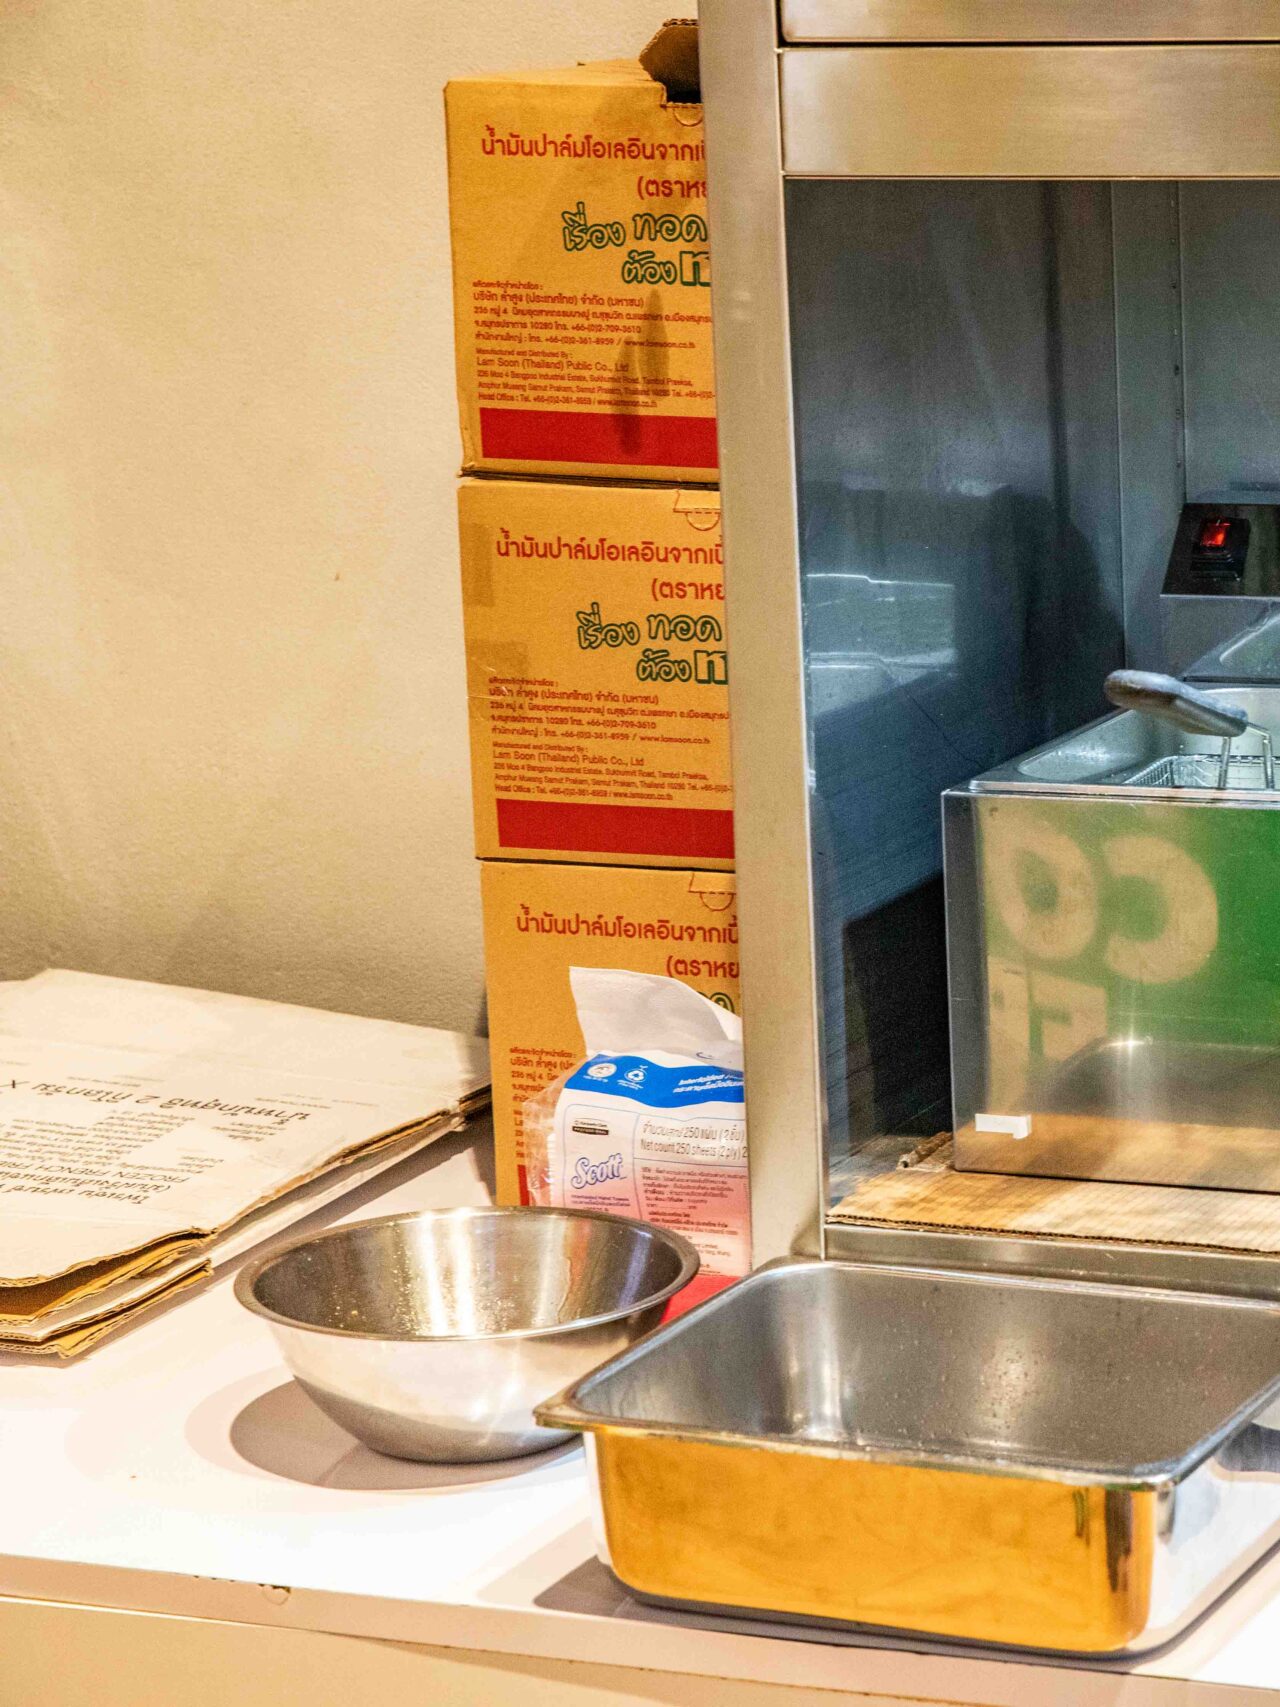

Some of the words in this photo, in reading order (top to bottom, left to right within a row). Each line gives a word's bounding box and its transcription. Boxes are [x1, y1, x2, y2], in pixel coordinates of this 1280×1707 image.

[646, 612, 723, 642] ทอด
[513, 750, 536, 761] Soon
[135, 1094, 160, 1104] 2
[683, 1126, 699, 1138] 250
[676, 1142, 690, 1155] 250
[35, 1164, 111, 1177] FRENCH
[112, 1170, 190, 1184] FROZEN
[571, 1152, 622, 1189] Scott
